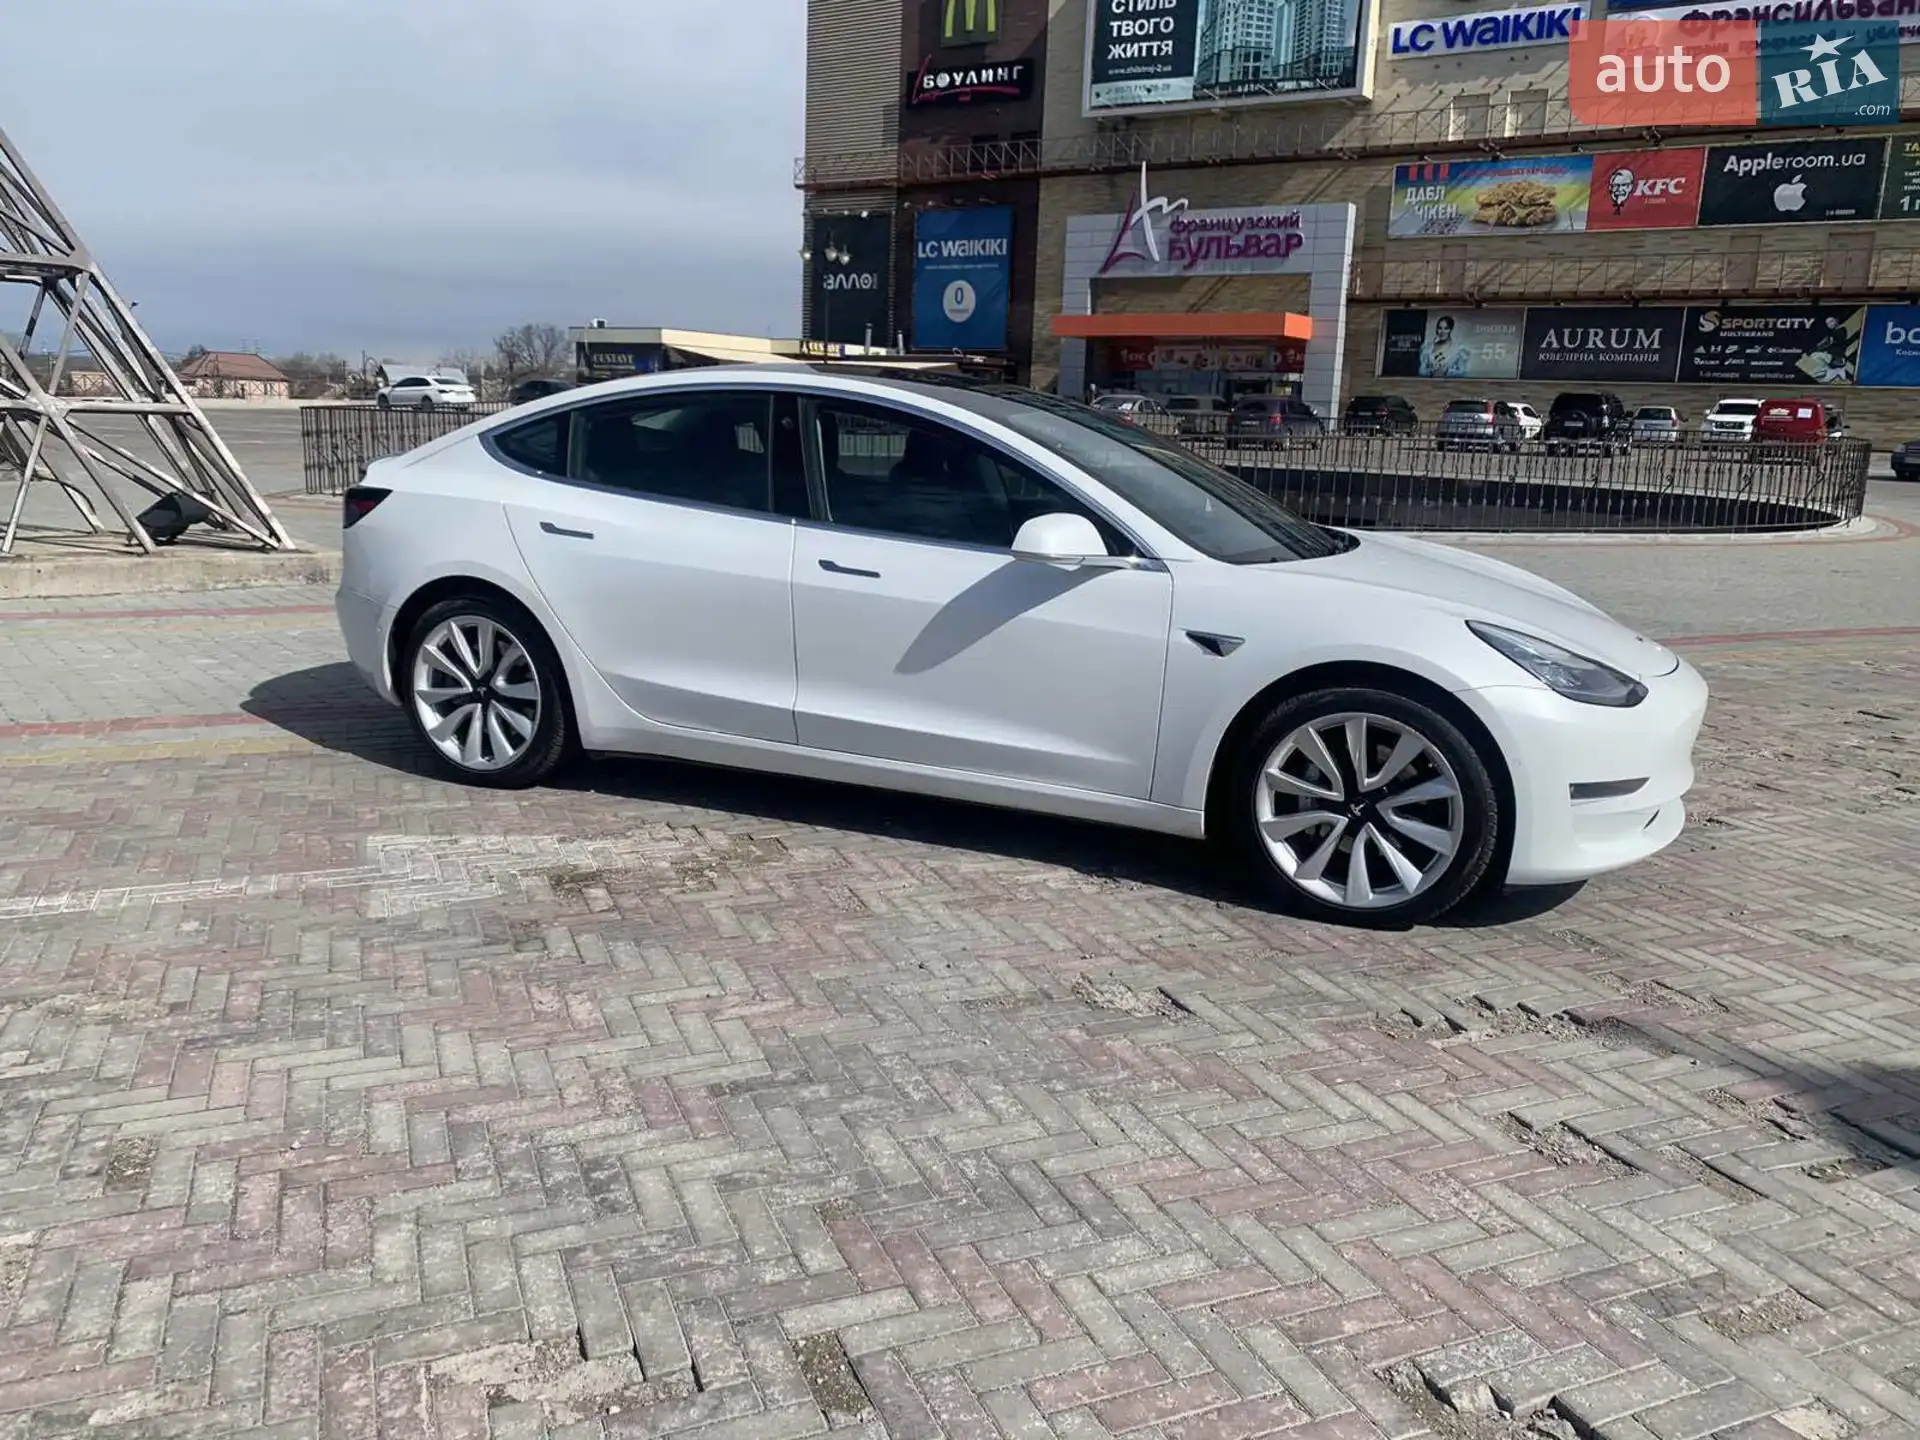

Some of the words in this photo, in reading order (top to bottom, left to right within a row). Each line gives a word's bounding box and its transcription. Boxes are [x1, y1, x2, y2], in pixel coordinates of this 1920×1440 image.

[1109, 16, 1174, 37] ТВОГО
[1392, 24, 1437, 54] LC
[1107, 40, 1173, 59] ЖИТТЯ
[923, 66, 1024, 89] БОУЛИНГ
[1723, 151, 1866, 177] Appleroom.ua
[1406, 185, 1446, 203] ДАБЛ
[1633, 176, 1686, 197] KFC
[918, 241, 939, 258] LC
[955, 287, 964, 304] 0
[1721, 317, 1815, 329] SPORTCITY
[1540, 328, 1663, 349] AURUM
[1599, 352, 1660, 362] КОМПАНІЯ
